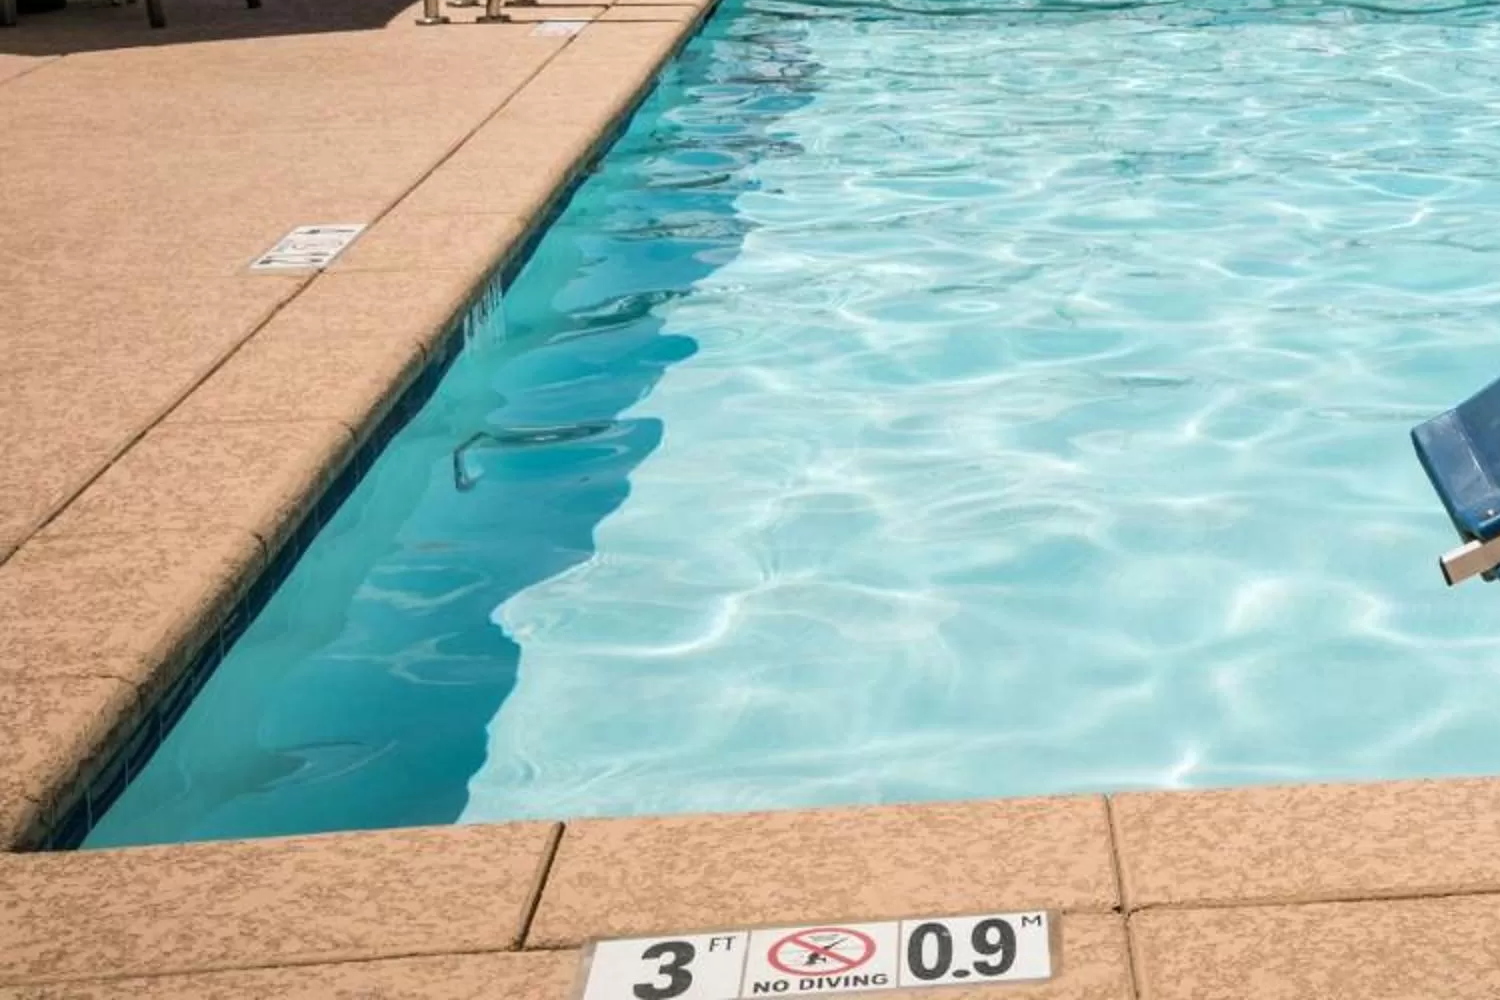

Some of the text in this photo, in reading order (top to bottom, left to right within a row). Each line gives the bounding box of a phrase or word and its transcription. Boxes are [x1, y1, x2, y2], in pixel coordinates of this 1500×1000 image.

[632, 935, 737, 1000] 3 FT
[907, 914, 1042, 981] 0.9 M
[753, 973, 889, 994] NO DIVING
